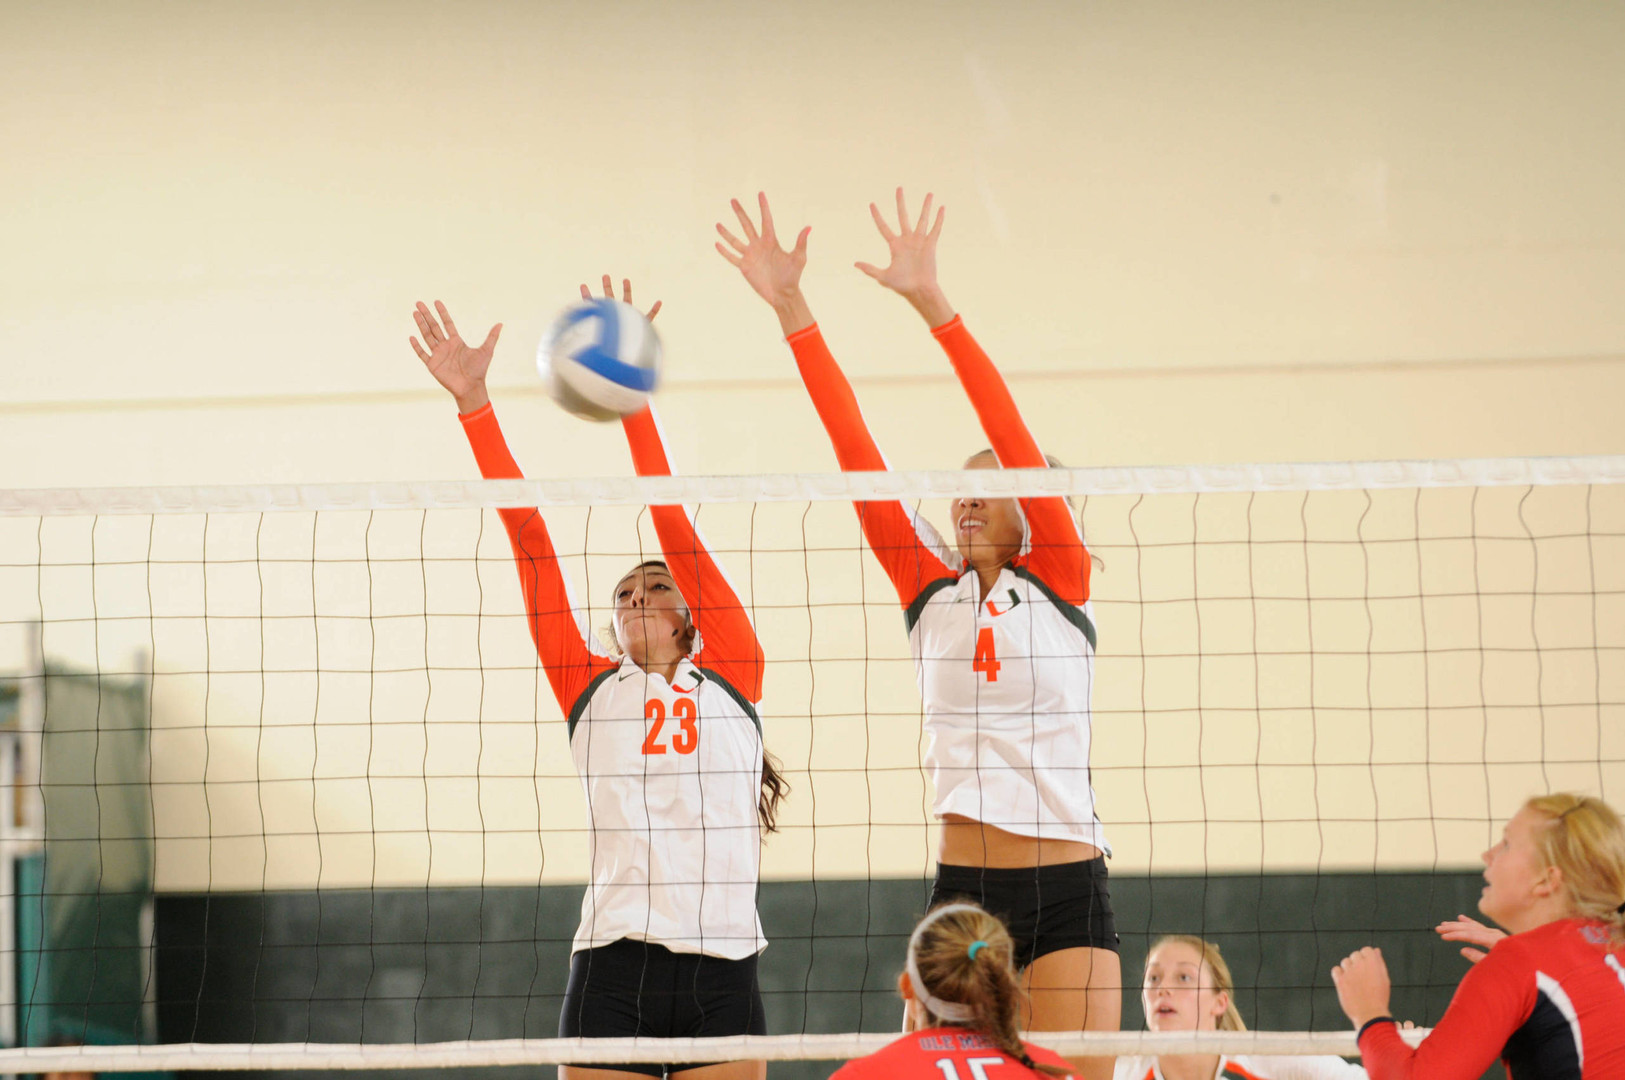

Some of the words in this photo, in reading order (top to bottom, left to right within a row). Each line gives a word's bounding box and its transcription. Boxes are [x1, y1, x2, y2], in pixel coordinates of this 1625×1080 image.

[972, 627, 1001, 682] 4
[641, 698, 698, 755] 23
[920, 1035, 956, 1051] OLE
